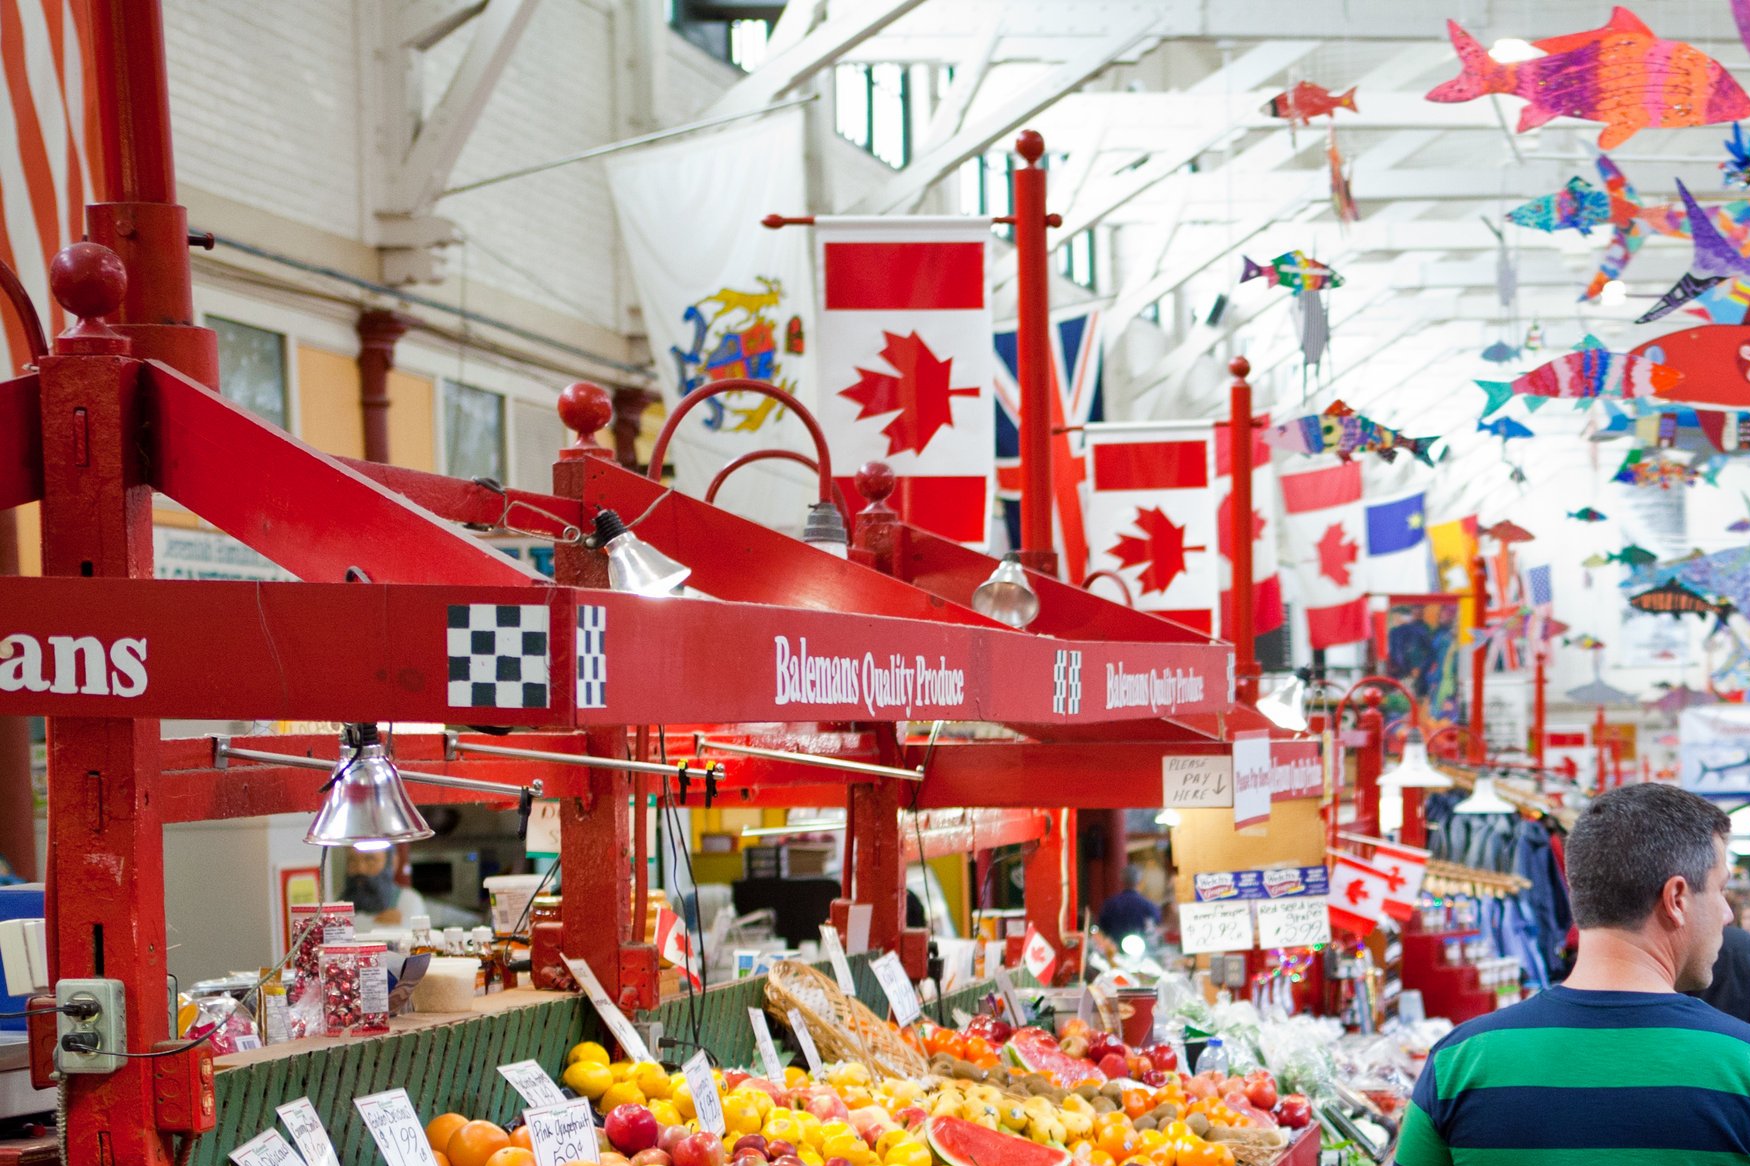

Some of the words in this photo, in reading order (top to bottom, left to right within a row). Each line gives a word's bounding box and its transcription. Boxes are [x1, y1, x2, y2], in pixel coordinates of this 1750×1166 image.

[775, 635, 859, 705] Balemans
[862, 651, 917, 718] Quality
[915, 656, 965, 707] Produce
[1106, 662, 1150, 709] Balemans
[1150, 667, 1177, 713] Quality
[1176, 666, 1204, 703] Produce
[1169, 758, 1208, 772] PLEASE
[1183, 772, 1211, 786] PAY
[1173, 789, 1207, 800] HERE
[533, 1119, 554, 1144] Pink
